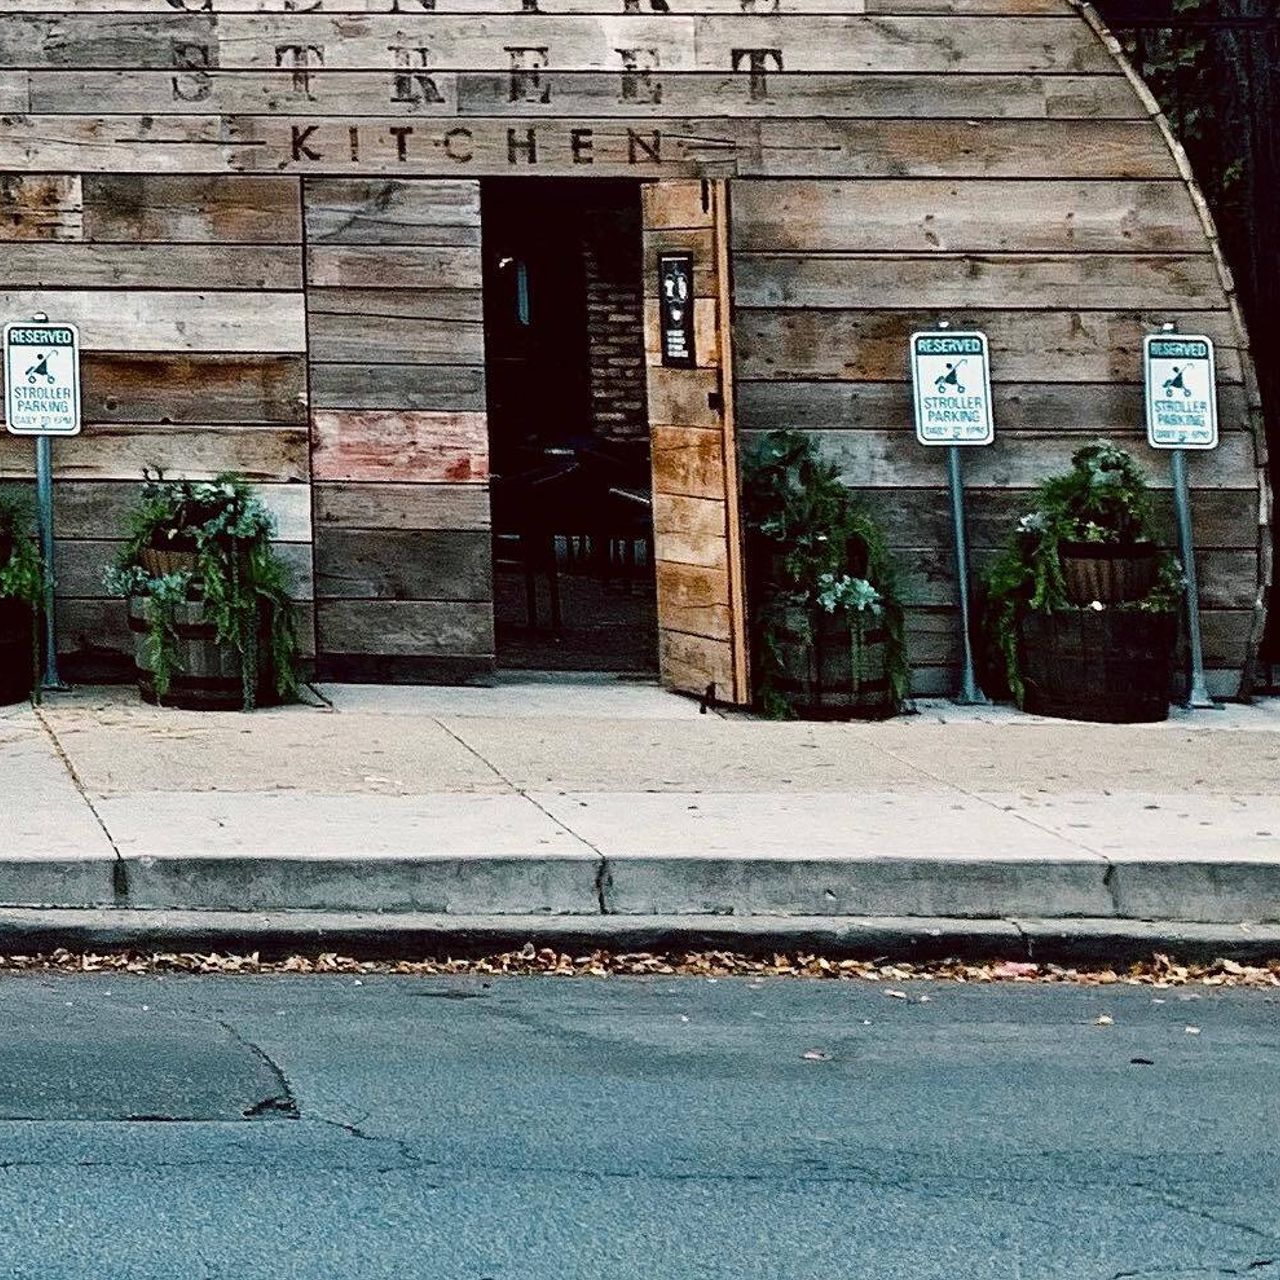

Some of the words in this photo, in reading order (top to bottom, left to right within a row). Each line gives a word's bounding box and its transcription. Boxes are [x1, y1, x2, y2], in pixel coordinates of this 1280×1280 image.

[172, 44, 784, 106] STREET
[290, 124, 662, 165] KITCHEN
[10, 329, 72, 344] RESERVED
[918, 338, 981, 353] RESERVED
[1149, 342, 1207, 357] RESERVED
[14, 386, 71, 400] STROLLER
[17, 400, 68, 413] PARKING
[924, 396, 983, 410] STROLLER
[1154, 400, 1207, 414] STROLLER
[927, 410, 980, 423] PARKING
[1157, 414, 1206, 427] PARKING
